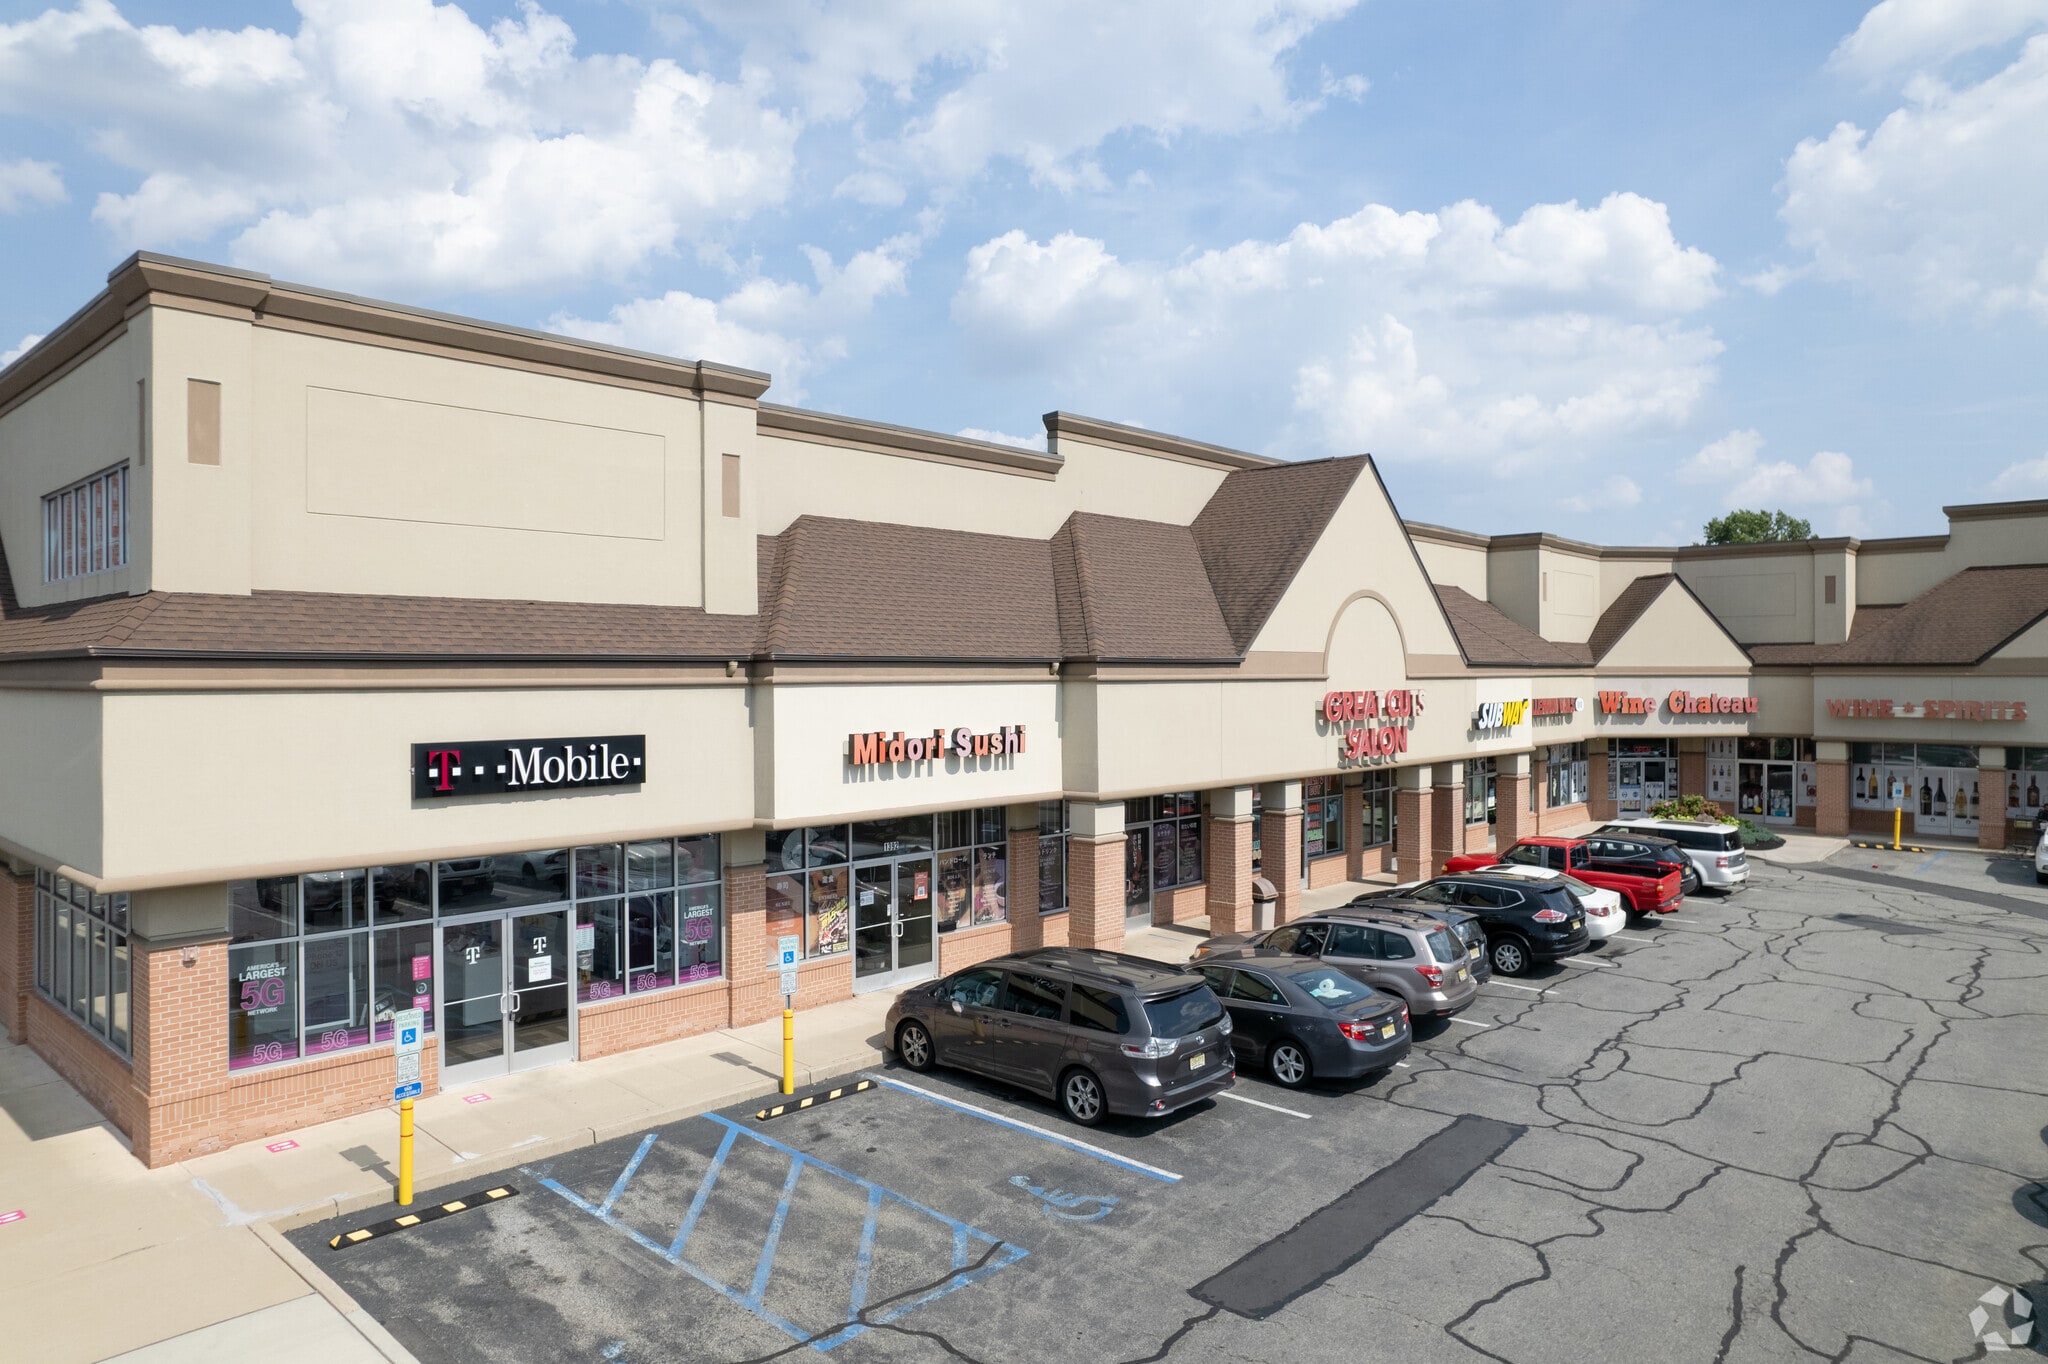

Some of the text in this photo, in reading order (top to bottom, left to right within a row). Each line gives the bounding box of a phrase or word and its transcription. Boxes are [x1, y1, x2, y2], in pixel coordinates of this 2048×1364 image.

[1323, 689, 1425, 722] GREAT CUTS
[1598, 691, 1657, 714] Wine
[1668, 690, 1758, 714] Chateau
[1826, 698, 2028, 722] WINE SPIRITS
[1478, 699, 1529, 729] SUBWAY
[849, 725, 1026, 765] Midori Sushi
[1344, 726, 1408, 759] SALON
[683, 908, 713, 919] LARGEST
[685, 917, 713, 941] 5G
[238, 966, 287, 982] LARGEST
[246, 961, 280, 972] AMERICA'S
[690, 963, 708, 980] 5G
[590, 981, 610, 1000] 5G
[637, 972, 656, 991] 5G
[240, 977, 285, 1010] 5G
[247, 1006, 278, 1016] NETWORK
[320, 1029, 349, 1050] 5G
[253, 1042, 282, 1064] 5G
